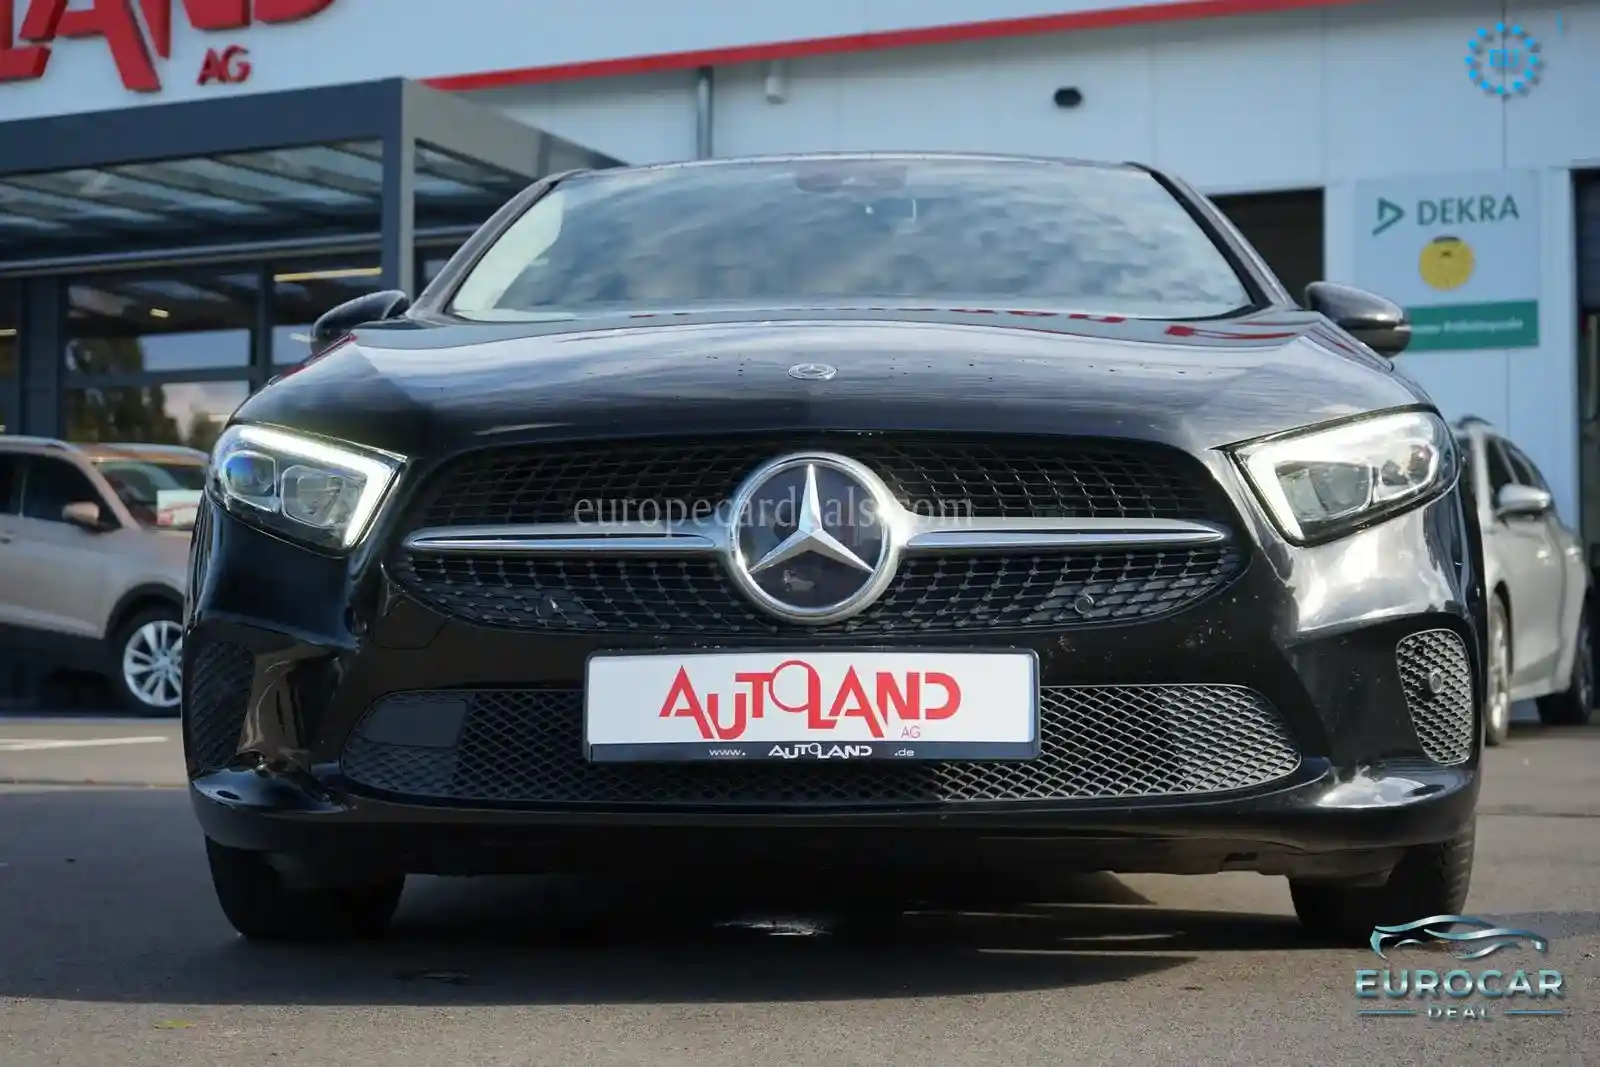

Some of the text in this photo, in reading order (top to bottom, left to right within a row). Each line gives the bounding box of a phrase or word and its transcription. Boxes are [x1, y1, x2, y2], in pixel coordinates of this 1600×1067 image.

[197, 45, 251, 85] AG
[1417, 194, 1520, 226] DEKRA
[659, 660, 961, 740] AUTOLAND
[901, 725, 922, 739] AG
[709, 748, 746, 757] www.
[894, 747, 915, 757] .de
